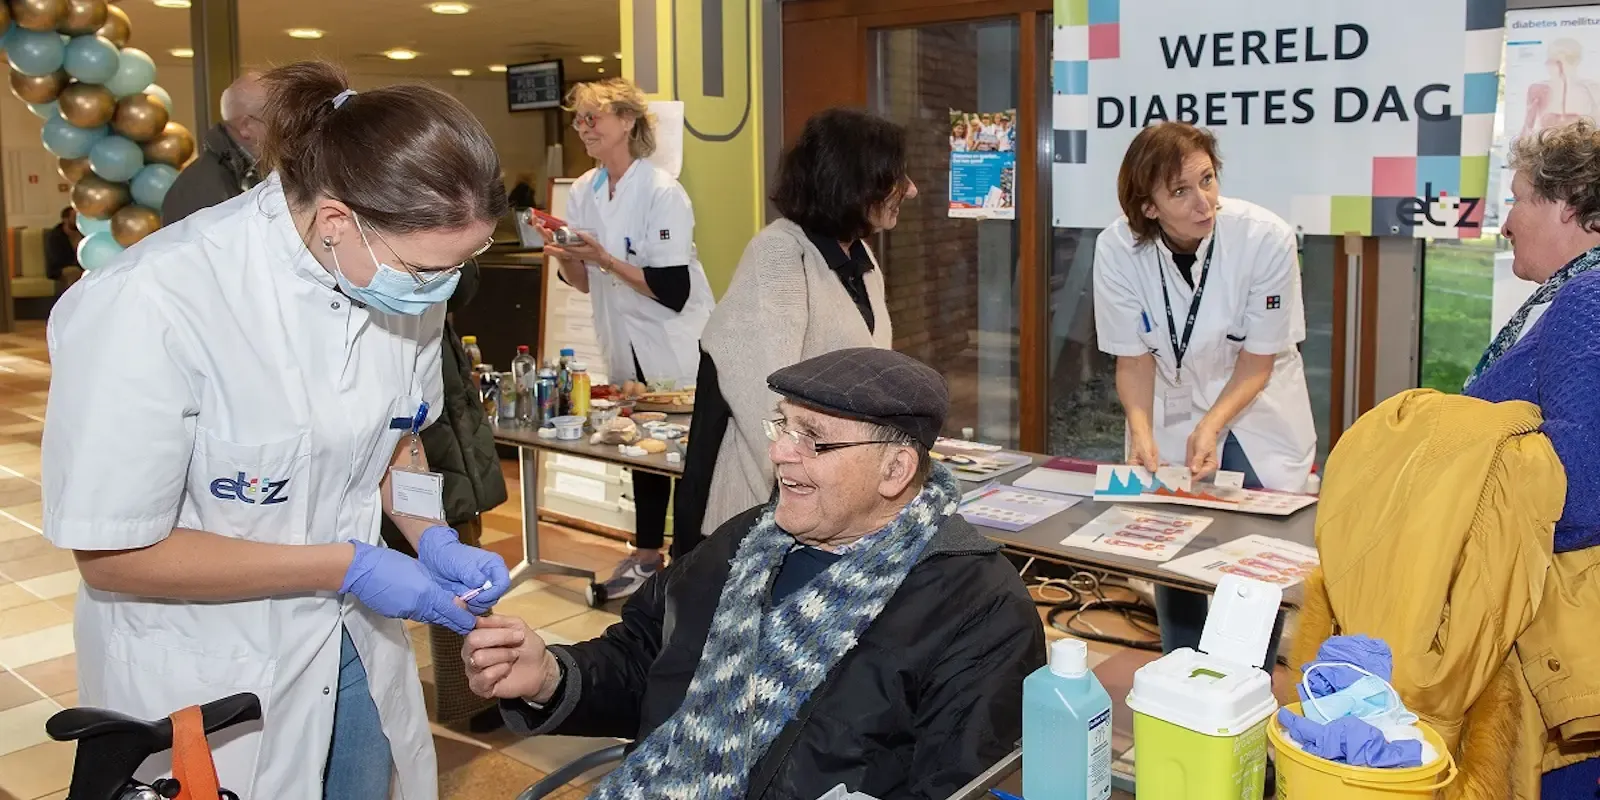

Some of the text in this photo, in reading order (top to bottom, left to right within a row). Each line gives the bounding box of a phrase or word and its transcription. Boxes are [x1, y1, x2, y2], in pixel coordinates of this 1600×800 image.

[1160, 24, 1369, 69] WERELD
[1512, 19, 1557, 29] diabetes
[1097, 83, 1453, 129] DIABETES DAG
